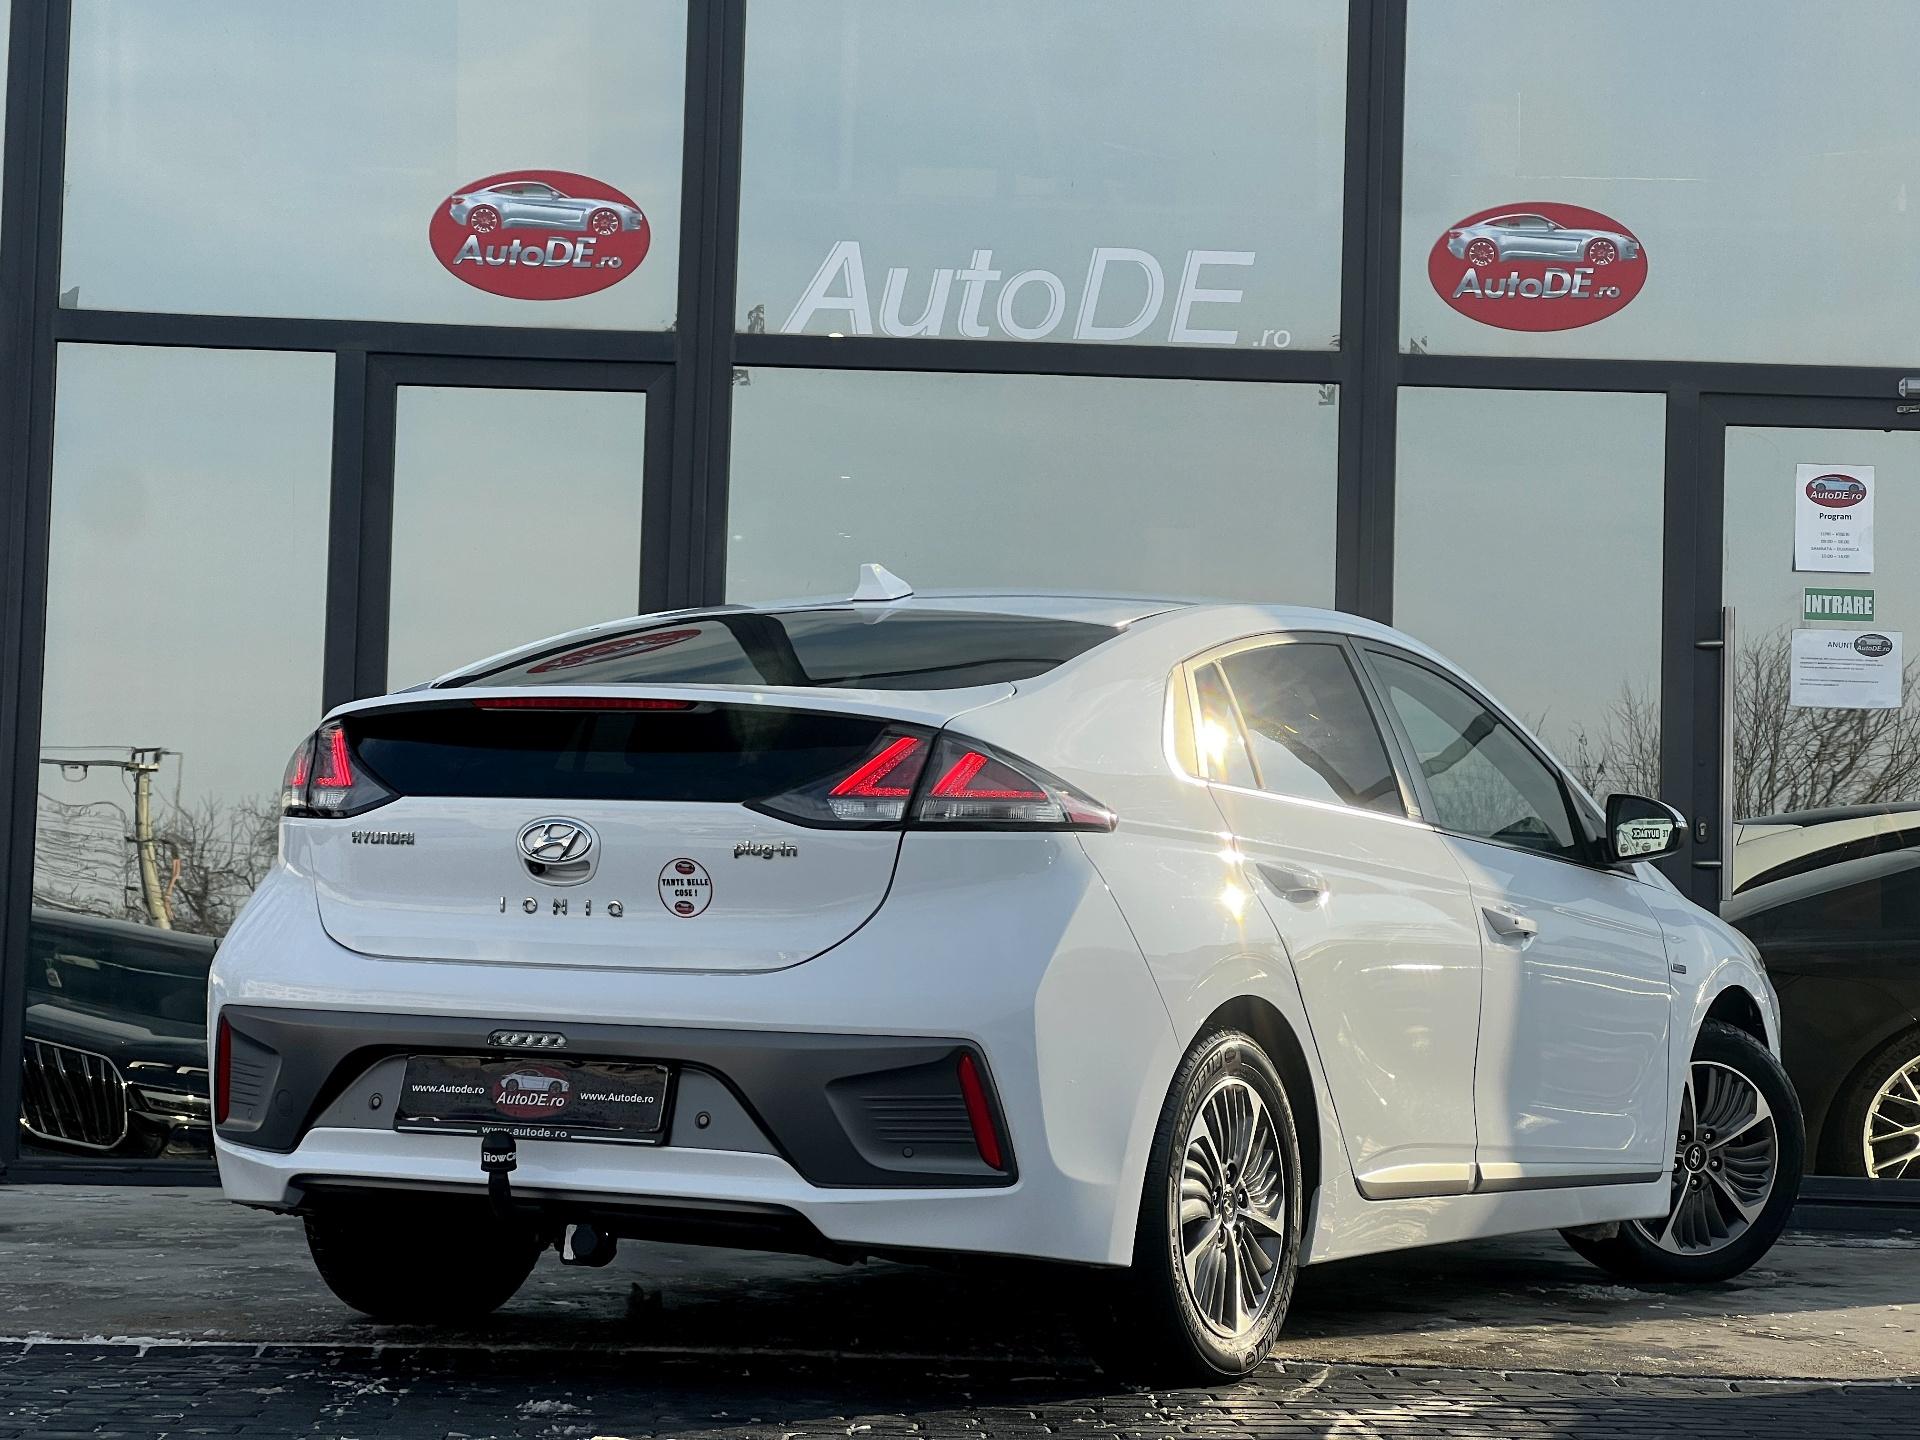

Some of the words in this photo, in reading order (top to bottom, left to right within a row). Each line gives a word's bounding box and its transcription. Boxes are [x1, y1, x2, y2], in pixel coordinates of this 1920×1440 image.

[1810, 491, 1862, 500] AutoDE.ro
[1819, 512, 1852, 521] Program
[1805, 594, 1873, 615] INTRARE
[352, 831, 415, 846] HYUNDAI
[734, 840, 799, 860] plug-in
[661, 878, 685, 887] TANTE
[686, 878, 709, 886] BELLE
[674, 889, 693, 897] COSE
[499, 896, 624, 918] IONIQ
[411, 1083, 485, 1095] www.Autode.ro
[495, 1091, 566, 1107] AutoDE.ro
[579, 1091, 654, 1103] www.Autode.ro
